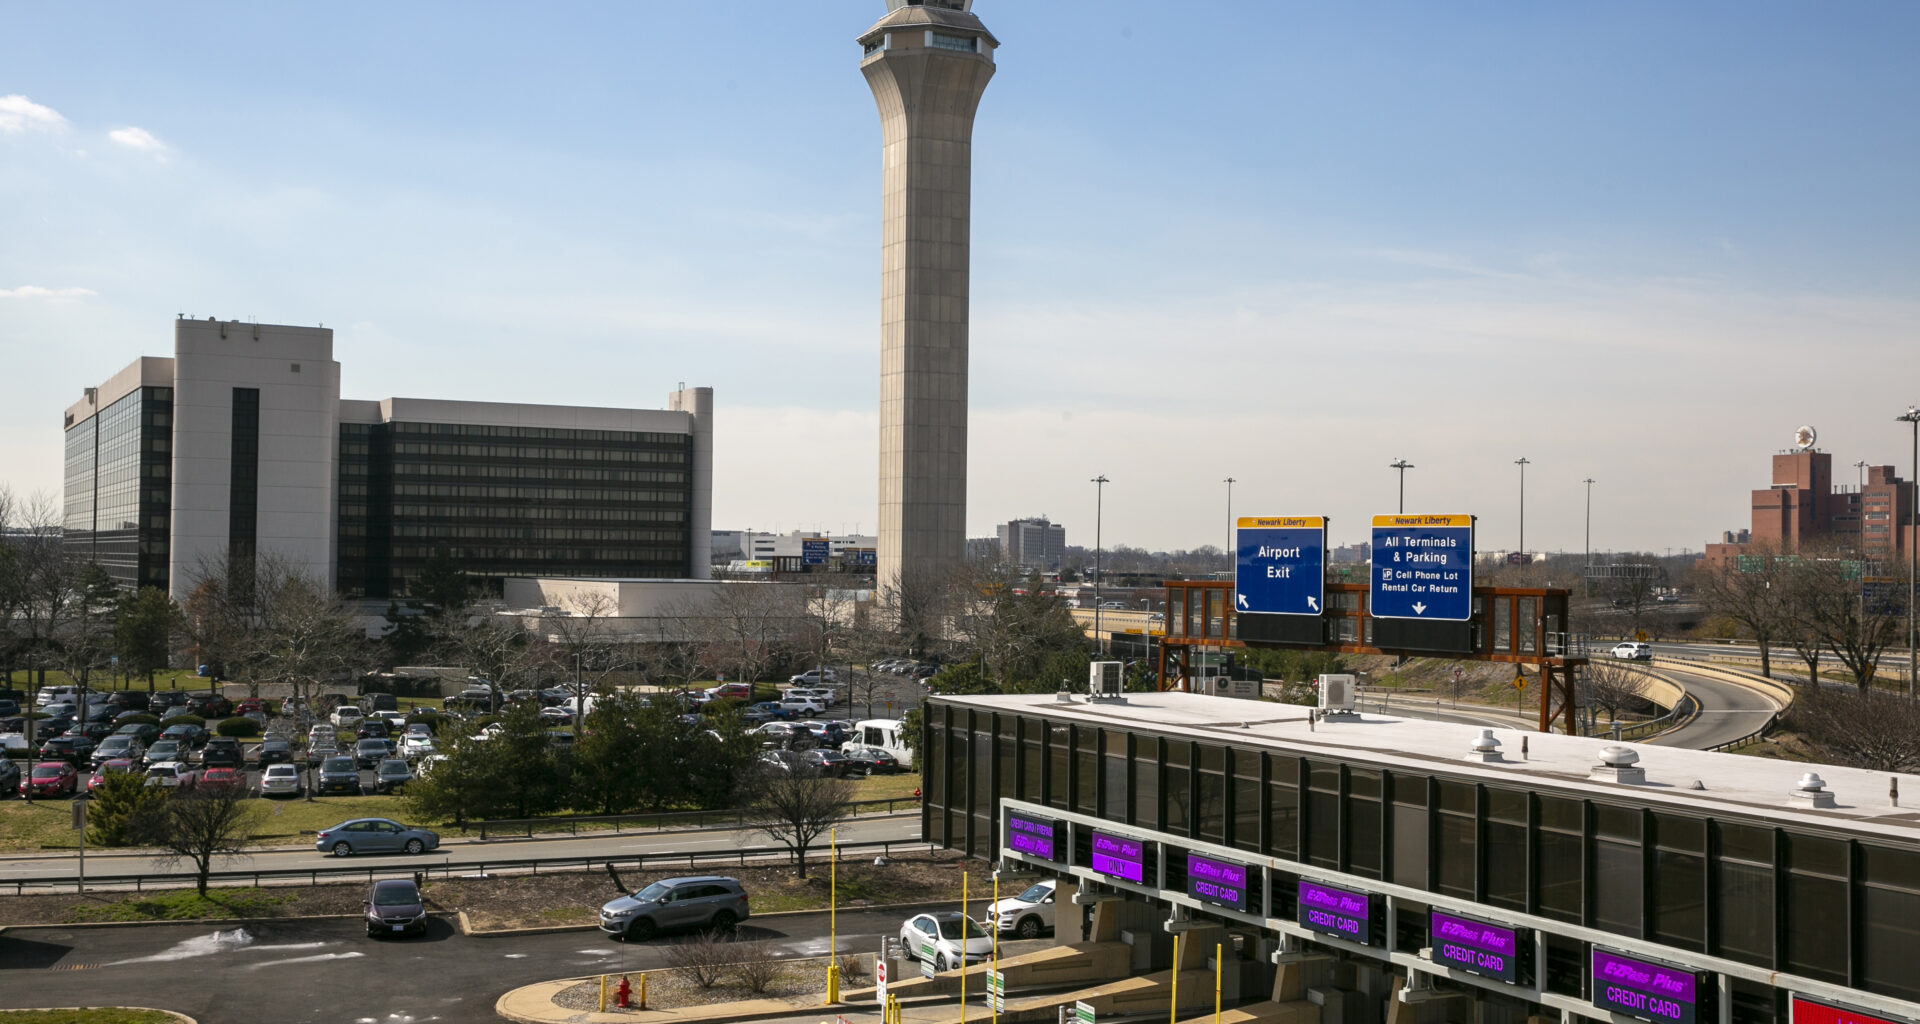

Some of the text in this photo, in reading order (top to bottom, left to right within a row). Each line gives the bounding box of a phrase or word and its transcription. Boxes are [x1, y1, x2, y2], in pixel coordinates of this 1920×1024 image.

[1283, 518, 1307, 527] Liberty
[1395, 516, 1452, 526] Newark Liberty
[1385, 536, 1457, 547] All Terminals
[1258, 545, 1300, 560] Airport
[1393, 551, 1447, 565] & Parking
[1267, 566, 1290, 579] Exit
[1395, 570, 1412, 579] Cell
[1415, 571, 1441, 580] Phone
[1444, 571, 1458, 580] Lot
[1382, 583, 1458, 593] Rental Car Return
[1121, 843, 1138, 857] Plus
[1108, 858, 1125, 874] ONLY
[1222, 868, 1240, 882] Plus
[1195, 881, 1238, 902] CREDIT CARD
[1340, 896, 1361, 912] Plus
[1308, 909, 1359, 934] CREDIT CARD
[1480, 930, 1506, 948] Plus
[1443, 943, 1504, 972] CREDIT CARD
[1652, 972, 1684, 993] Plus
[1606, 986, 1681, 1020] CREDIT CARD
